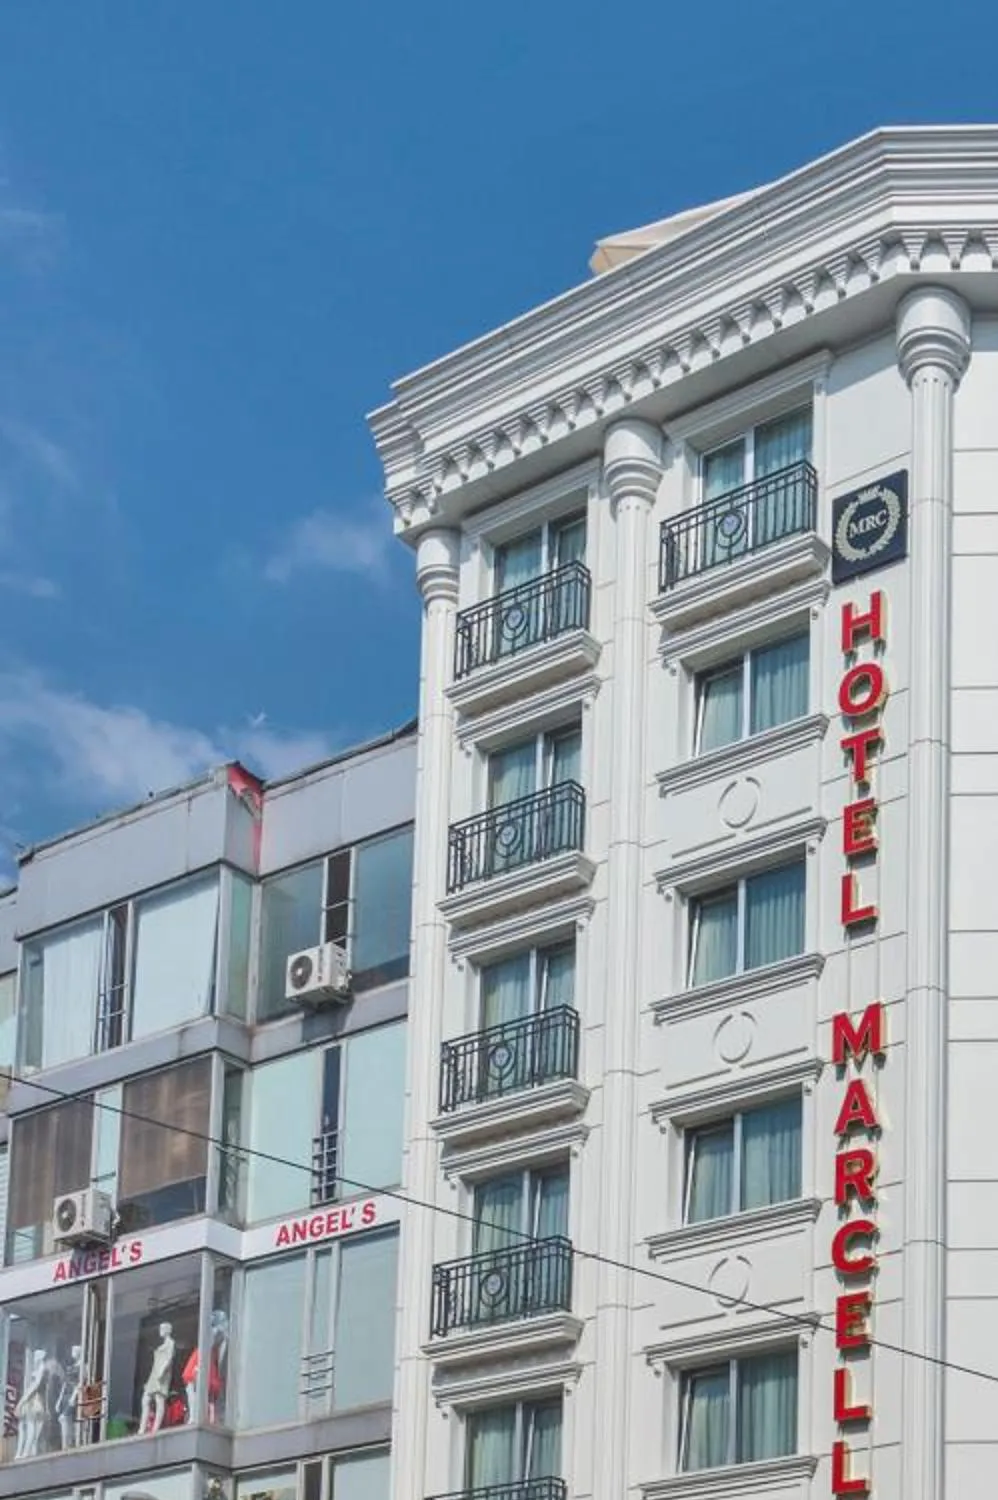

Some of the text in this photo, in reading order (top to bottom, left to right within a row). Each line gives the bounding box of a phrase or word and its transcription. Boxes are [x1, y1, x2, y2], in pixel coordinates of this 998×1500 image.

[848, 509, 888, 539] MRC
[838, 589, 887, 927] HOTEL
[275, 1201, 377, 1247] ANGEL'S
[53, 1241, 143, 1283] ANGEL'S
